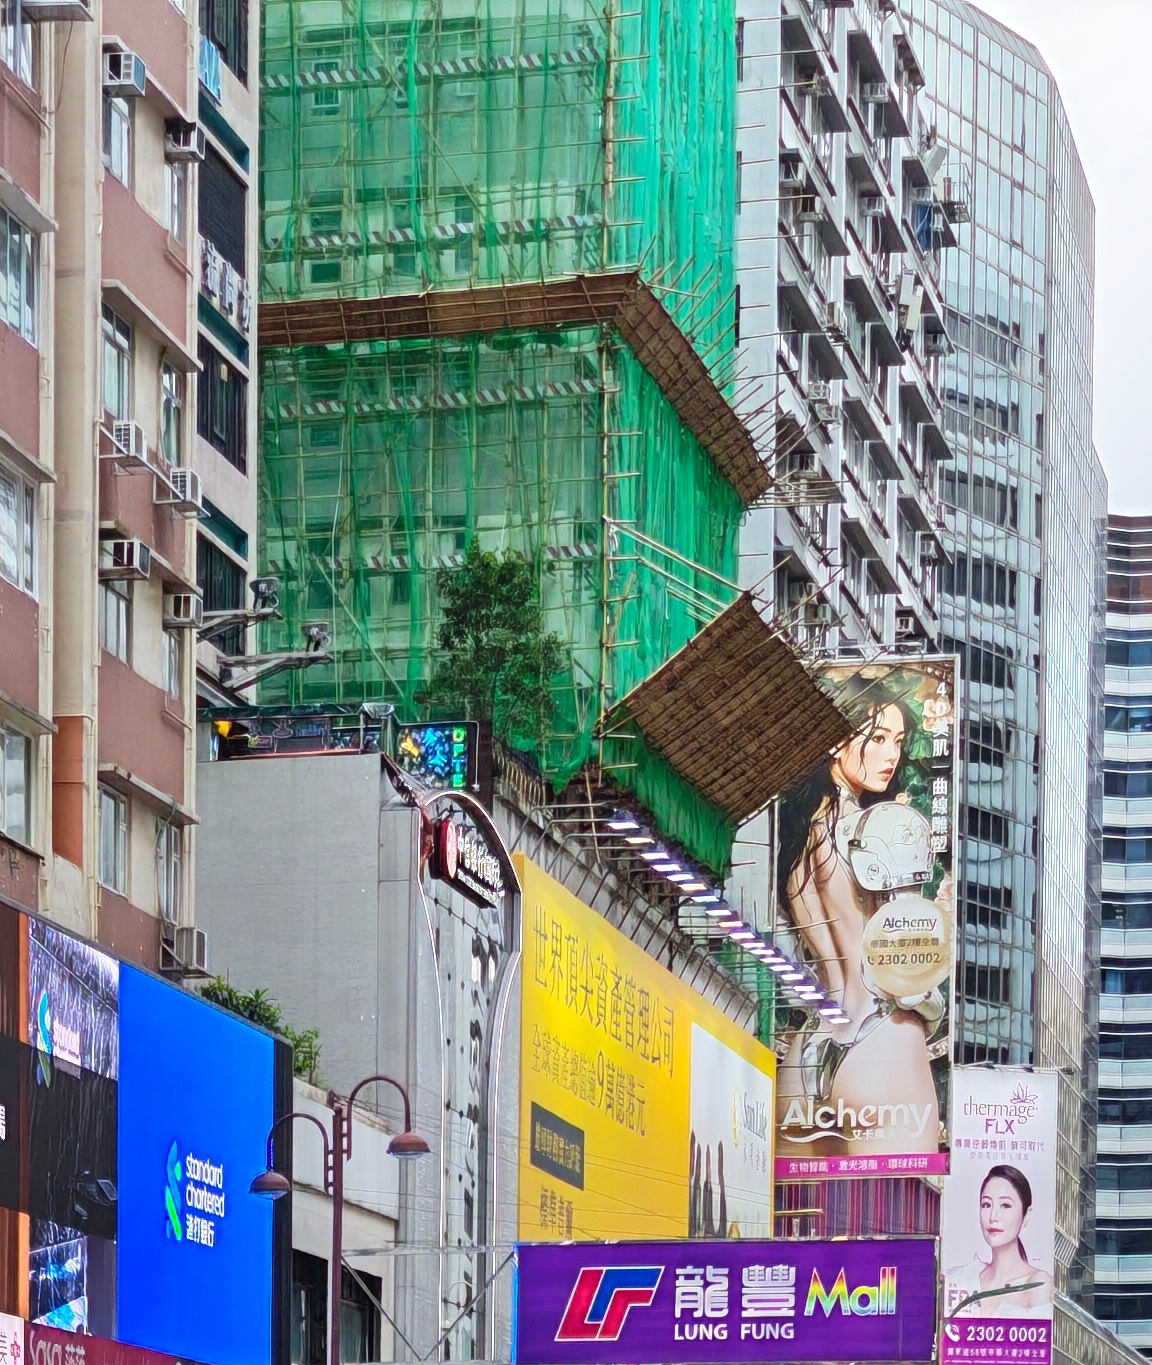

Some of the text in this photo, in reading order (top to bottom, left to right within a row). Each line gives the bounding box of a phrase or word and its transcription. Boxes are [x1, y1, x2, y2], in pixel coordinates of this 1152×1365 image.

[882, 917, 938, 931] Alchemy
[878, 953, 941, 965] 2302 0002
[533, 904, 675, 1079] 世界頂尖資產管理公司
[780, 1097, 934, 1138] Alchemy
[963, 1094, 1035, 1124] thermage
[985, 1118, 1015, 1135] FLX
[186, 1152, 223, 1189] standard
[186, 1181, 225, 1218] chartered
[804, 1265, 898, 1318] Mall
[674, 1322, 795, 1341] LUNG FUNG
[966, 1325, 1047, 1343] 2302 0002
